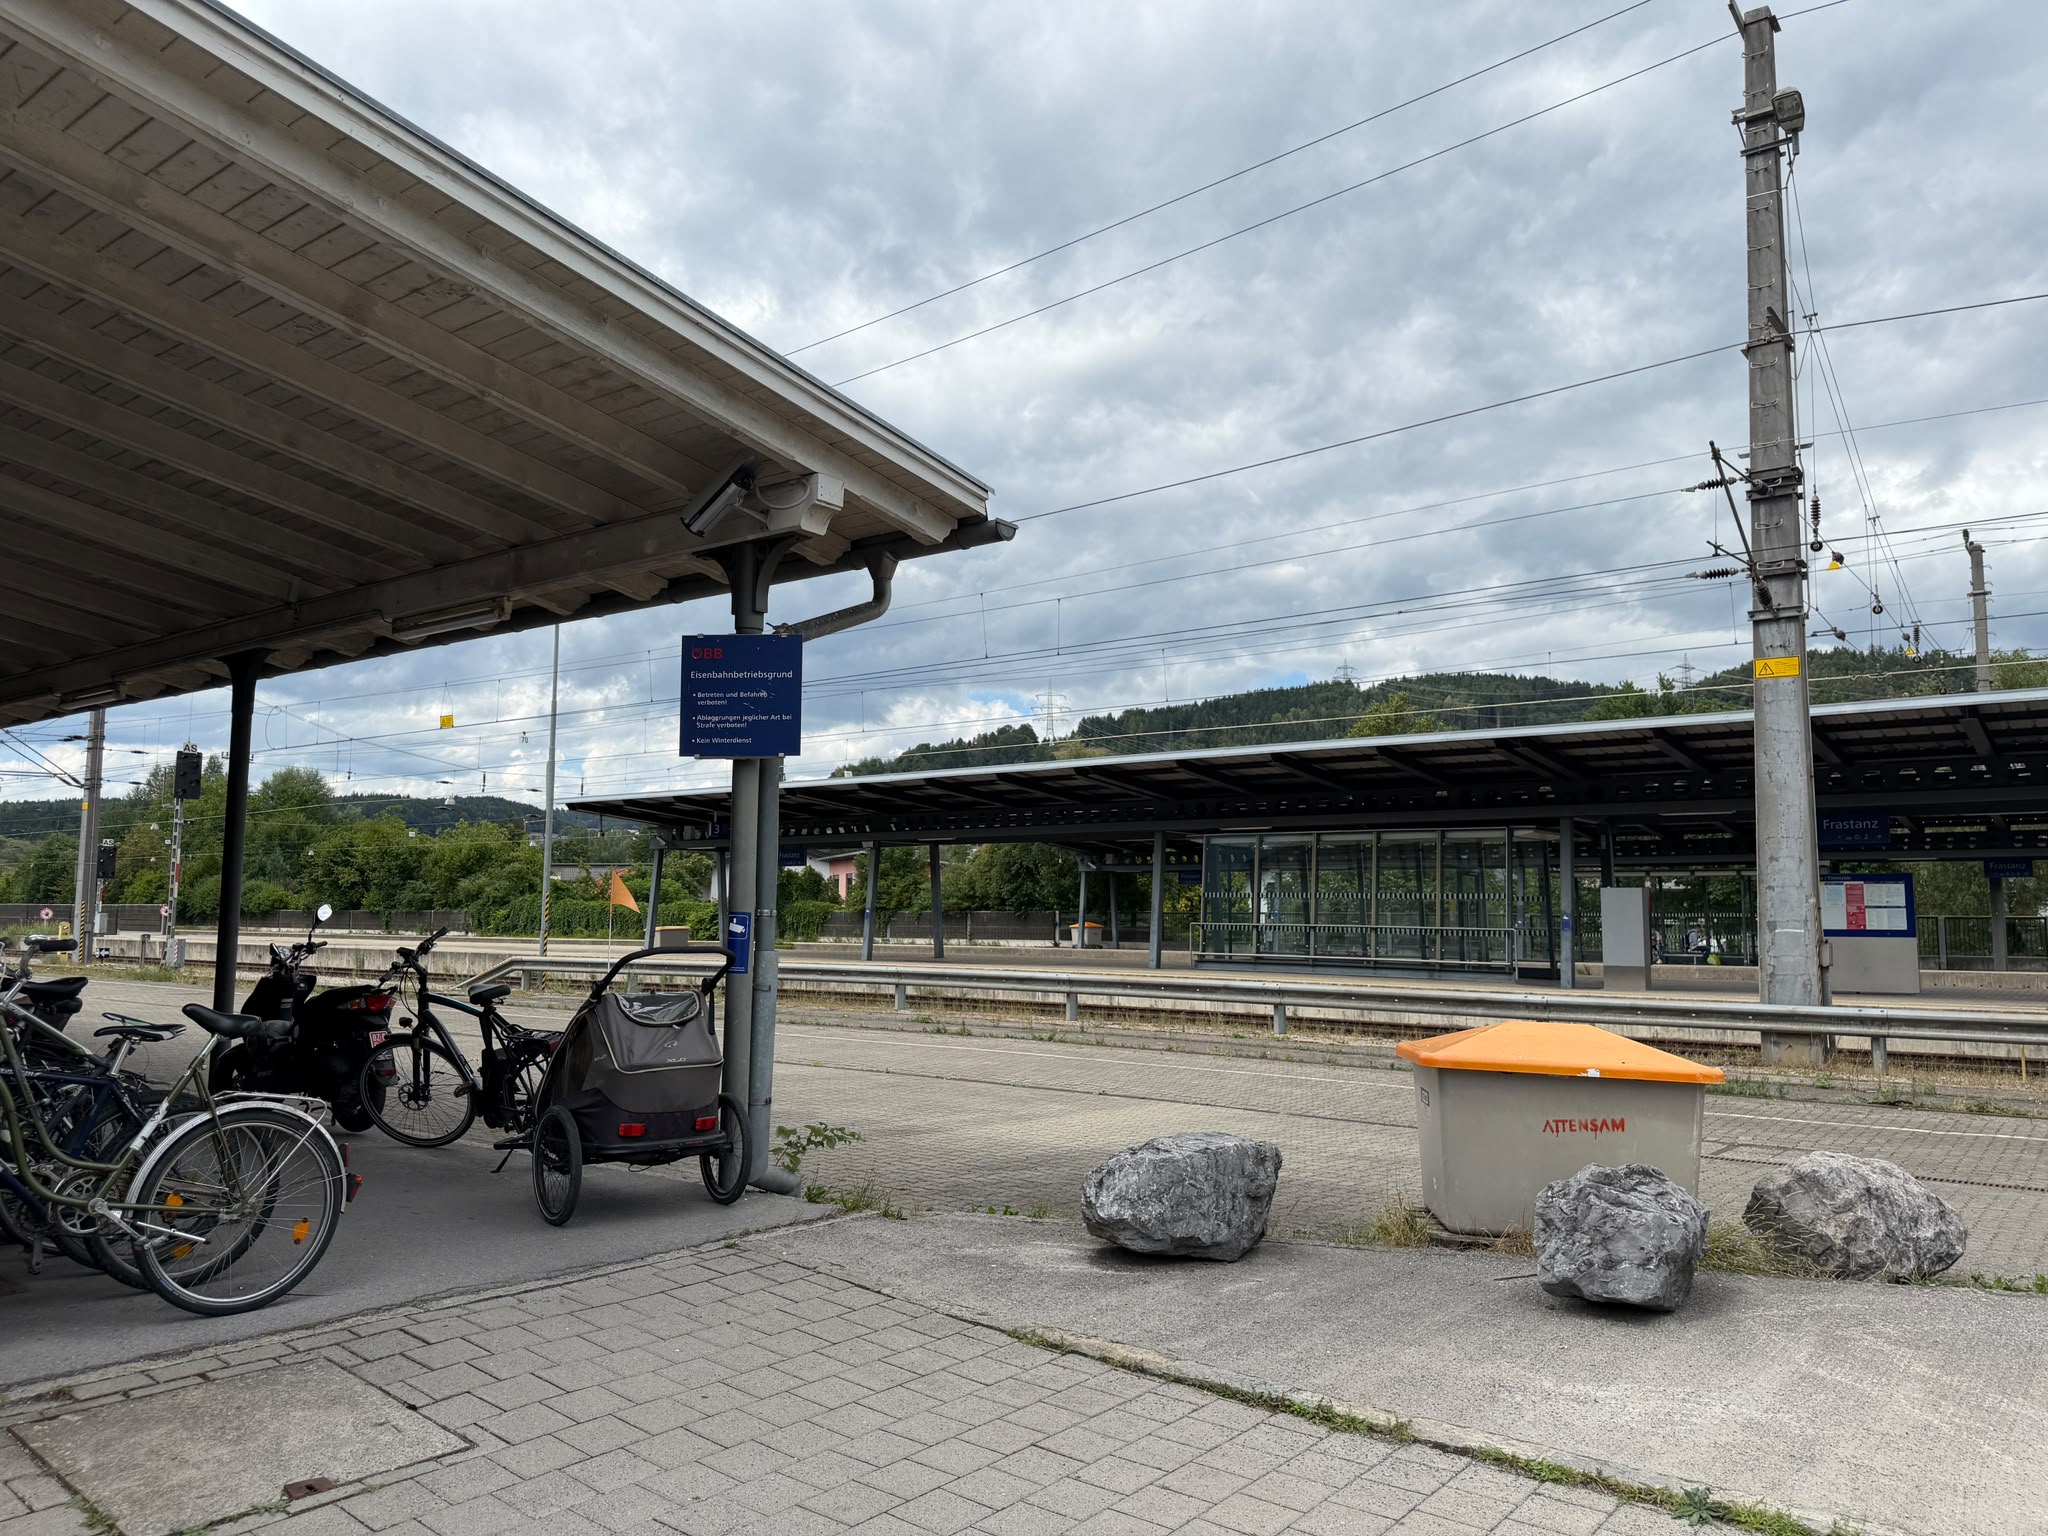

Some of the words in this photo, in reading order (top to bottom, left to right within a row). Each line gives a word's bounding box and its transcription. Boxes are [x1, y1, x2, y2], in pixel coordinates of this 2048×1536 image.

[690, 670, 793, 680] Eisenbahnbetriebsgrund
[696, 714, 741, 722] Ablagerungen
[742, 714, 770, 722] jeglicher
[184, 744, 198, 752] AS
[713, 824, 720, 834] 3
[1823, 819, 1879, 830] Frastanz
[1542, 1117, 1625, 1135] ATTENSAM
